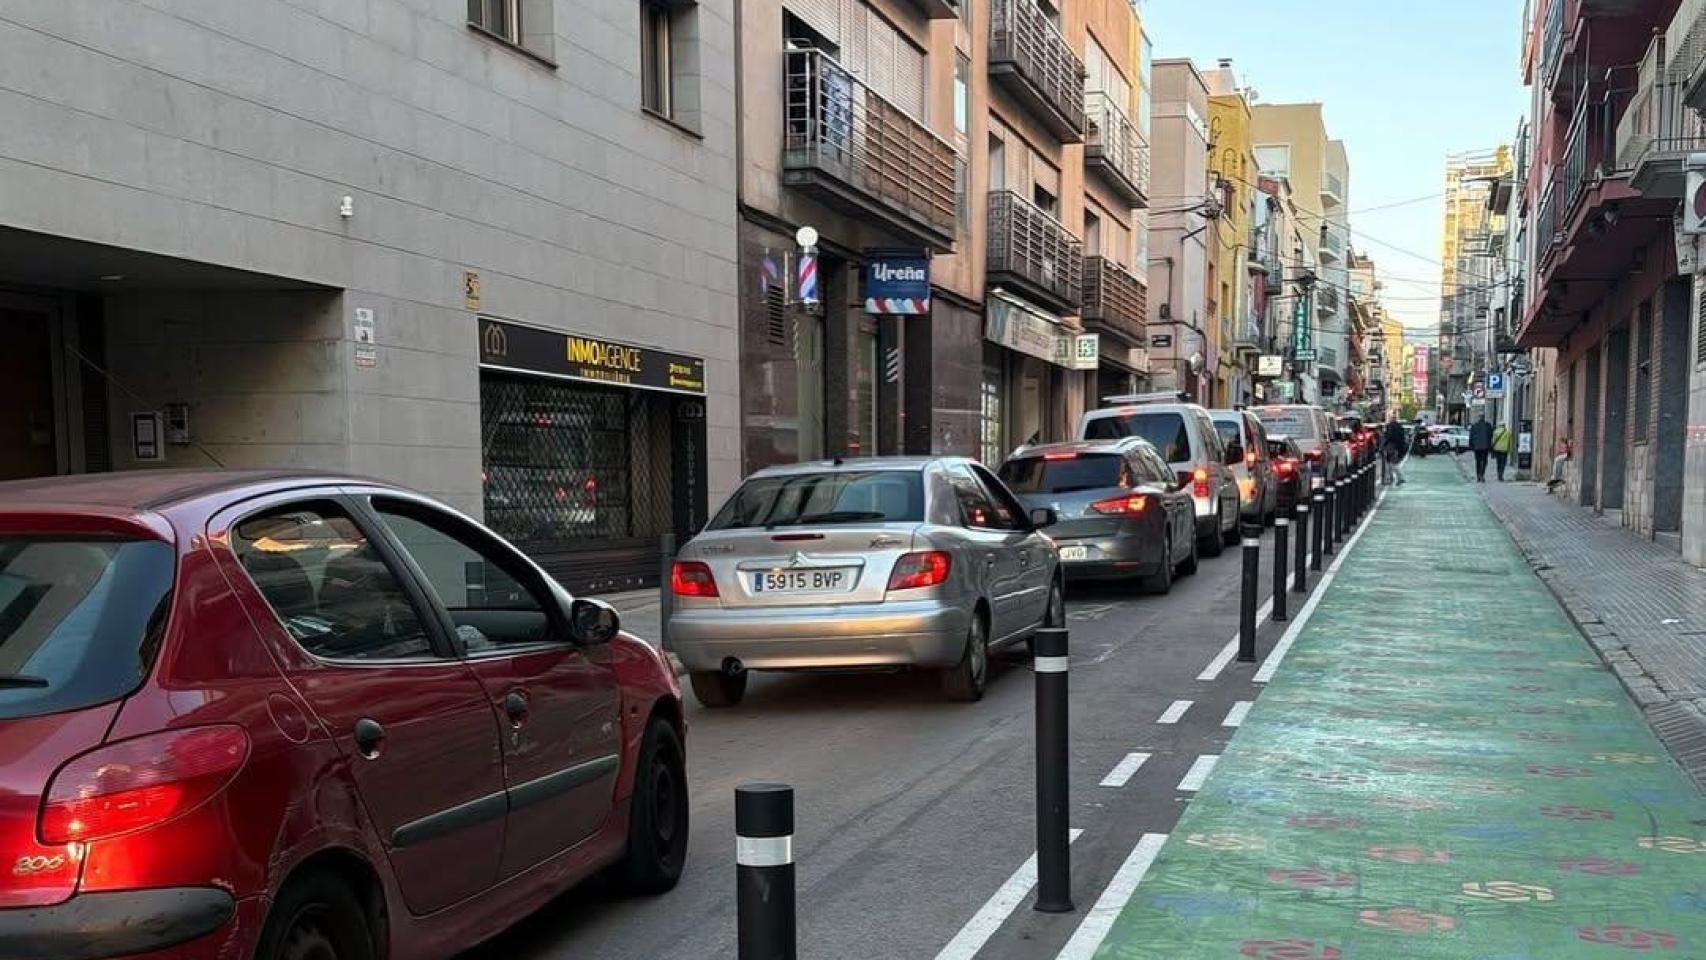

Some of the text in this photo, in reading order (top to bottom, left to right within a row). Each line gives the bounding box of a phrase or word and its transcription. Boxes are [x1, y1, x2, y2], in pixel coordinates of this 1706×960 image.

[871, 263, 925, 281] Ureña
[567, 337, 642, 371] INMOAGENCE
[1489, 375, 1500, 388] P
[767, 571, 842, 589] 5915 BVP
